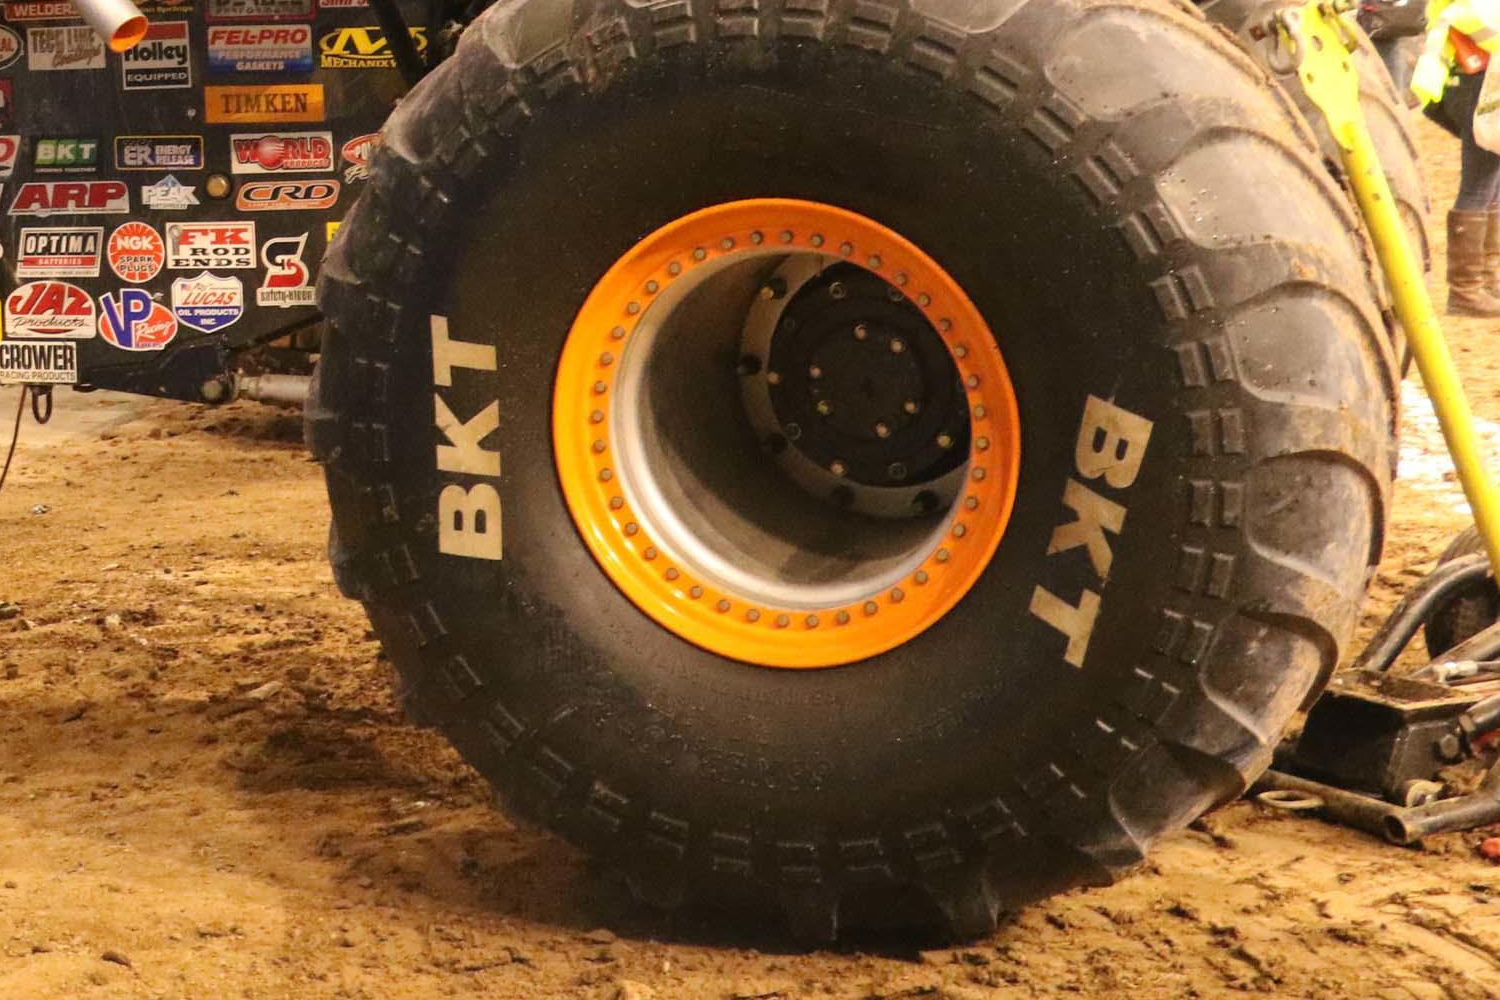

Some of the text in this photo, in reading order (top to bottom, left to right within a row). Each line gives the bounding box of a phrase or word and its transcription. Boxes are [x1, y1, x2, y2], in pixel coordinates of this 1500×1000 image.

[13, 2, 77, 18] WELDER
[210, 29, 308, 46] FEL-PRO
[235, 61, 285, 71] GASKETS
[127, 71, 187, 82] EQUIPPED
[220, 92, 309, 114] TIMKEN
[37, 143, 96, 161] BKT
[155, 144, 192, 156] ENERGY
[155, 155, 195, 166] RELEASE
[13, 182, 127, 210] ARP
[142, 185, 199, 204] PEAK
[243, 184, 335, 202] CRD
[26, 235, 96, 254] OPTIMA
[116, 236, 154, 251] NGK
[180, 228, 250, 245] FK
[119, 255, 154, 264] SPARK
[190, 247, 250, 256] ROD
[119, 264, 155, 273] PLUGS
[172, 258, 251, 267] ENDS
[8, 282, 92, 316] JAZ
[182, 291, 237, 306] LUCAS
[101, 289, 152, 349] VP
[194, 308, 239, 316] PRODUCTS
[0, 344, 76, 371] CROWER
[0, 371, 76, 381] RACING PRODUCTS
[430, 314, 503, 562] BKT
[1028, 393, 1154, 669] BKT
